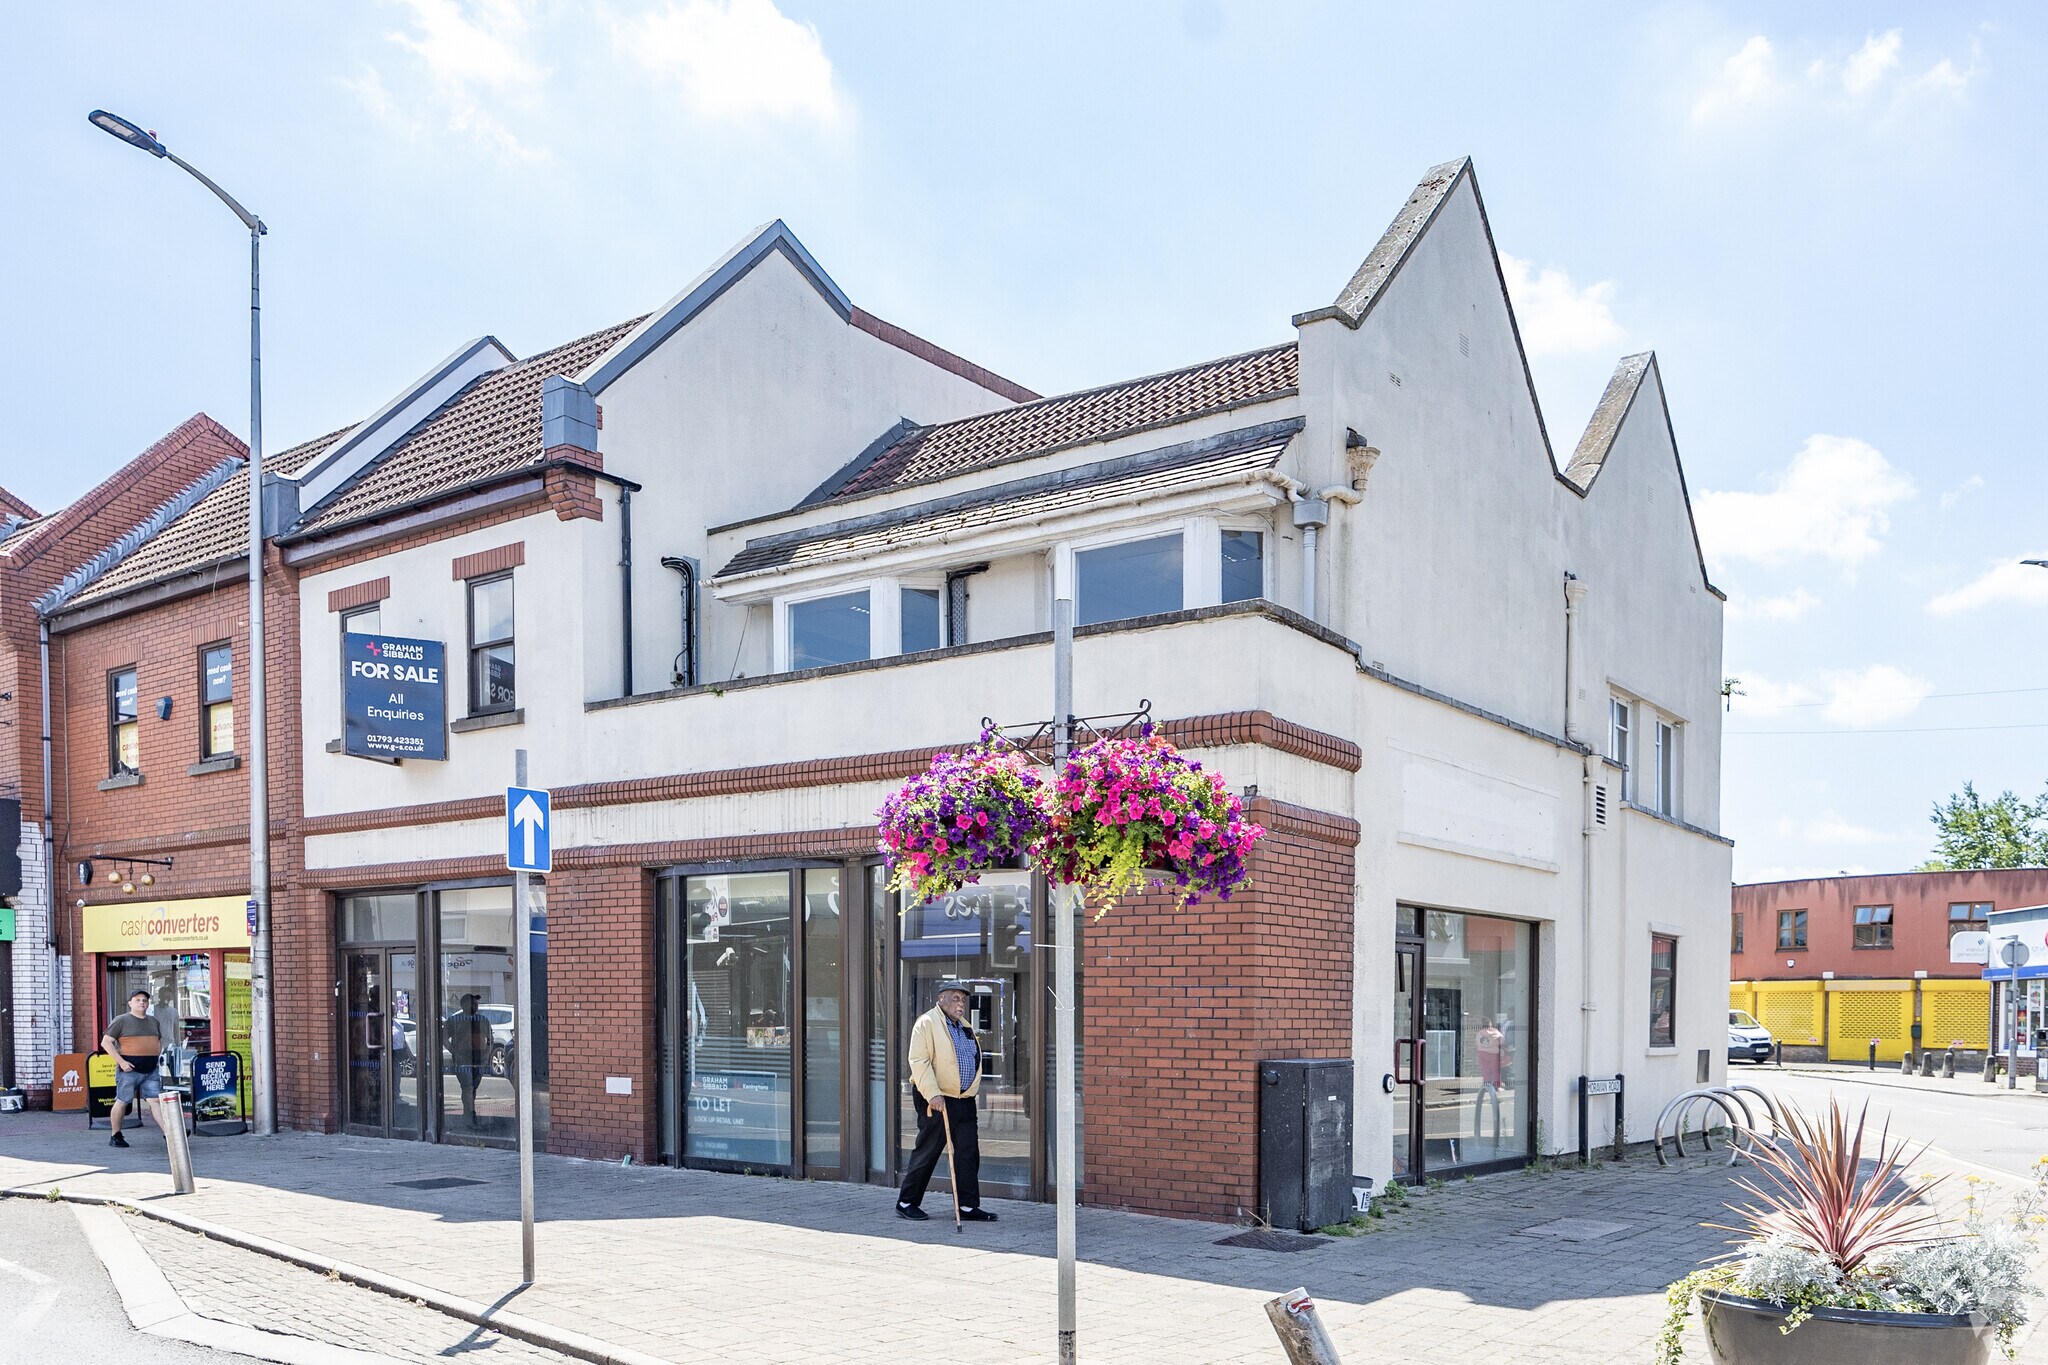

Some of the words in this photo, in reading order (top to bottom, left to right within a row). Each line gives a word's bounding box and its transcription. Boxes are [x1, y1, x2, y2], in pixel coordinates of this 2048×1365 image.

[381, 642, 423, 654] GRAHAM
[383, 650, 423, 661] SIBBALD
[351, 661, 389, 679] FOR
[393, 664, 438, 684] SALE
[388, 693, 404, 705] All
[367, 706, 424, 721] Enquiries
[366, 734, 392, 744] 01793
[394, 736, 424, 746] 423351
[367, 742, 424, 752] www.g-s.co.uk
[120, 913, 220, 937] cashconverters
[205, 1061, 226, 1069] SEND
[200, 1072, 231, 1081] RECEIVE
[702, 1076, 728, 1084] GRAHAM
[202, 1078, 229, 1087] MONEY
[703, 1083, 728, 1091] SIBBALD
[1608, 1081, 1620, 1091] ROAD
[694, 1096, 710, 1111] TO
[713, 1097, 732, 1112] LET
[694, 1115, 707, 1123] LOCK
